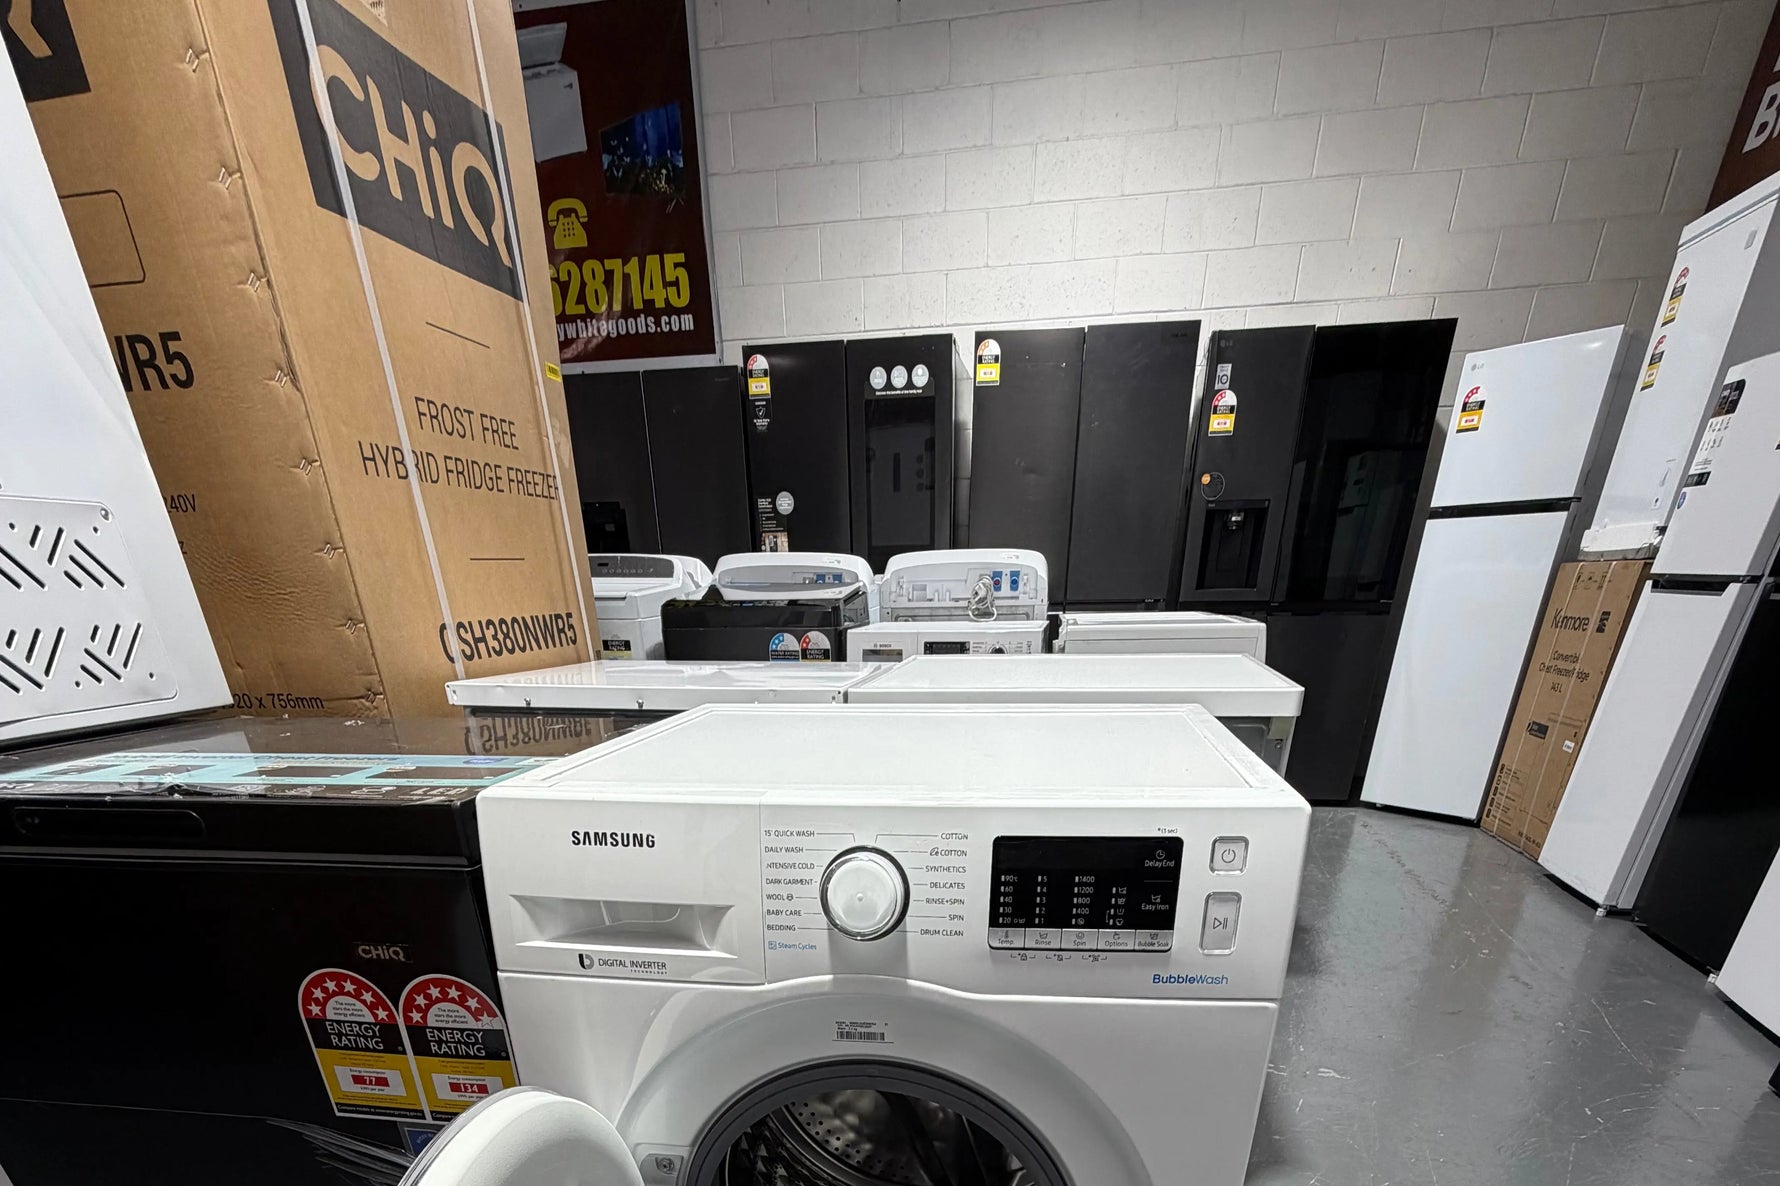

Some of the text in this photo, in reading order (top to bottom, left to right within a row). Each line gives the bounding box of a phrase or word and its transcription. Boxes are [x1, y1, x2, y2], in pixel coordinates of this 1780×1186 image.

[310, 44, 512, 268] CHiQ
[557, 313, 694, 342] ywhitegoods.com
[415, 396, 519, 450] FROST FREE
[358, 440, 559, 500] HYBRID FRIDGE FREEZER
[163, 493, 197, 513] 40V
[439, 612, 577, 664] CSH380NWR5
[1553, 650, 1580, 664] Convertibl
[1538, 662, 1553, 674] Chst
[255, 696, 266, 709] x
[266, 693, 325, 709] 756mm
[774, 829, 795, 838] QUICK
[940, 832, 969, 840] COTTON
[571, 830, 656, 849] SAMSUNG
[764, 845, 783, 853] DAILY
[940, 848, 968, 857] COTTON
[766, 862, 815, 870] NTENSIVE COLD
[1144, 860, 1162, 868] Delay
[925, 865, 967, 874] SYNTHETICS
[783, 878, 814, 886] GARMENT
[929, 881, 966, 890] DELICATES
[765, 893, 786, 901] WOOL
[925, 897, 965, 905] RINSE+SPIN
[1077, 907, 1090, 915] 400
[1141, 903, 1156, 911] Easy
[784, 909, 802, 917] CARE
[766, 924, 796, 932] BEDDING
[920, 928, 964, 937] DRUM CLEAN
[777, 941, 817, 951] Steam Cycles
[1034, 938, 1052, 946] Rinse
[1073, 939, 1087, 947] Spin
[1104, 940, 1129, 948] Options
[1156, 940, 1169, 948] Soak
[358, 944, 406, 962] CHiQ
[598, 958, 667, 970] DIGITAL INVERTER
[1152, 973, 1229, 985] BubbleWash
[325, 1021, 380, 1037] ENERGY
[426, 1028, 483, 1043] ENERGY
[330, 1034, 384, 1050] RATING
[430, 1042, 486, 1057] RATING
[363, 1076, 376, 1085] 77
[460, 1083, 479, 1093] 134
